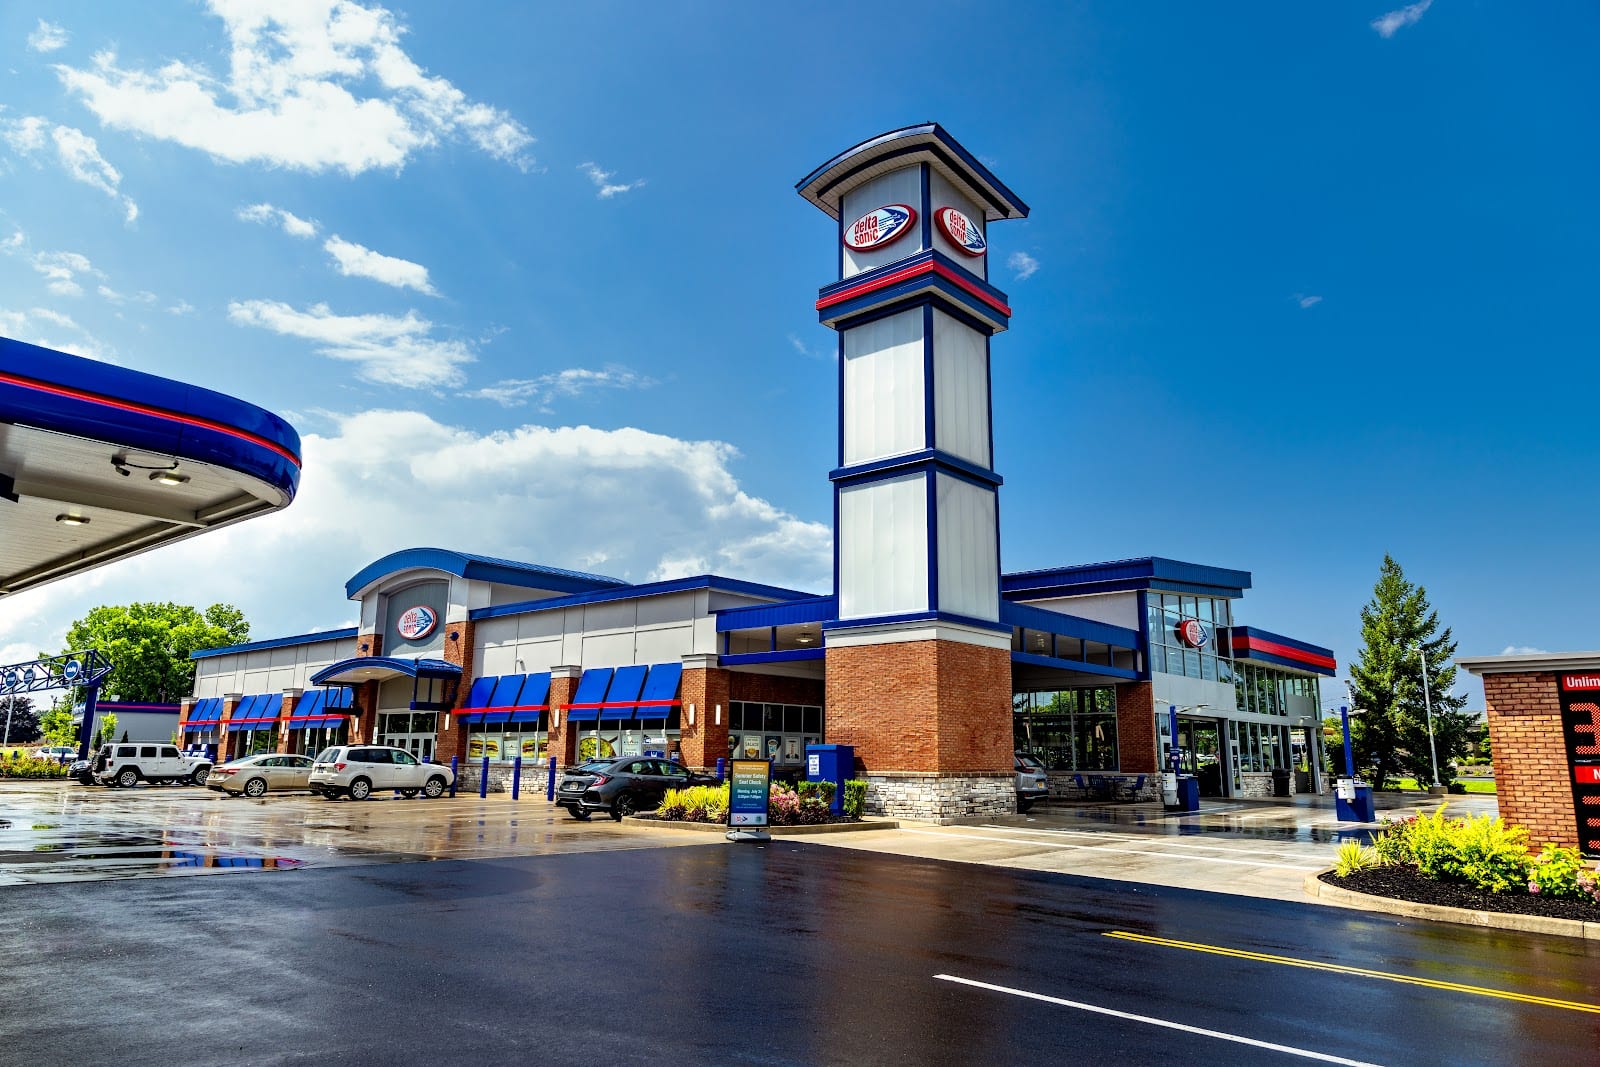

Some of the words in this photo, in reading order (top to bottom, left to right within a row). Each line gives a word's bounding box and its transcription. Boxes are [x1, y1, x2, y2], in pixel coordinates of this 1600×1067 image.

[855, 216, 878, 234] delta
[949, 210, 966, 230] delta
[855, 229, 879, 245] sonic
[949, 223, 967, 243] sonic
